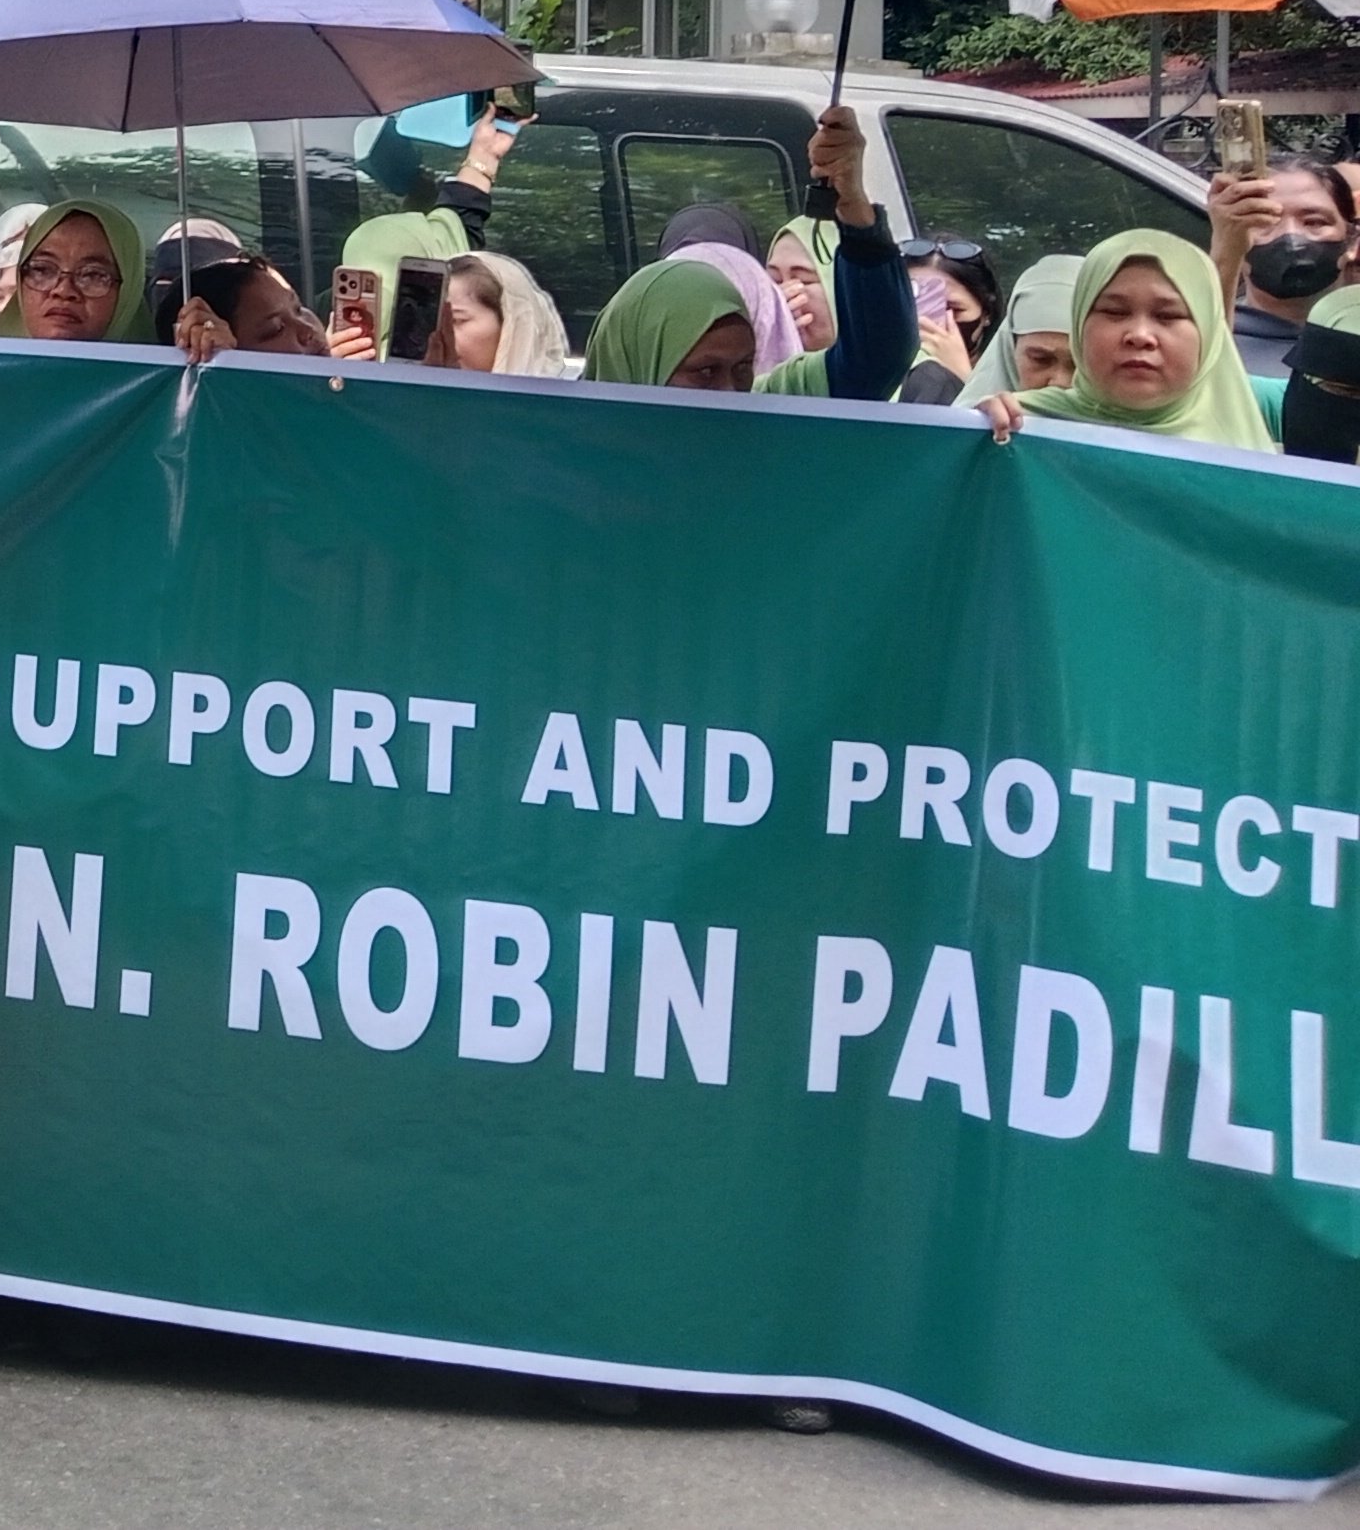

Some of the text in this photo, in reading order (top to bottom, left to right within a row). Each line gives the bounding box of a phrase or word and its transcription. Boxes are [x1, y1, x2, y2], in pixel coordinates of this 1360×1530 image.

[521, 712, 774, 826] AND
[826, 740, 1359, 908] PROTECT
[227, 872, 738, 1085] ROBIN
[806, 935, 1360, 1189] PADILL
